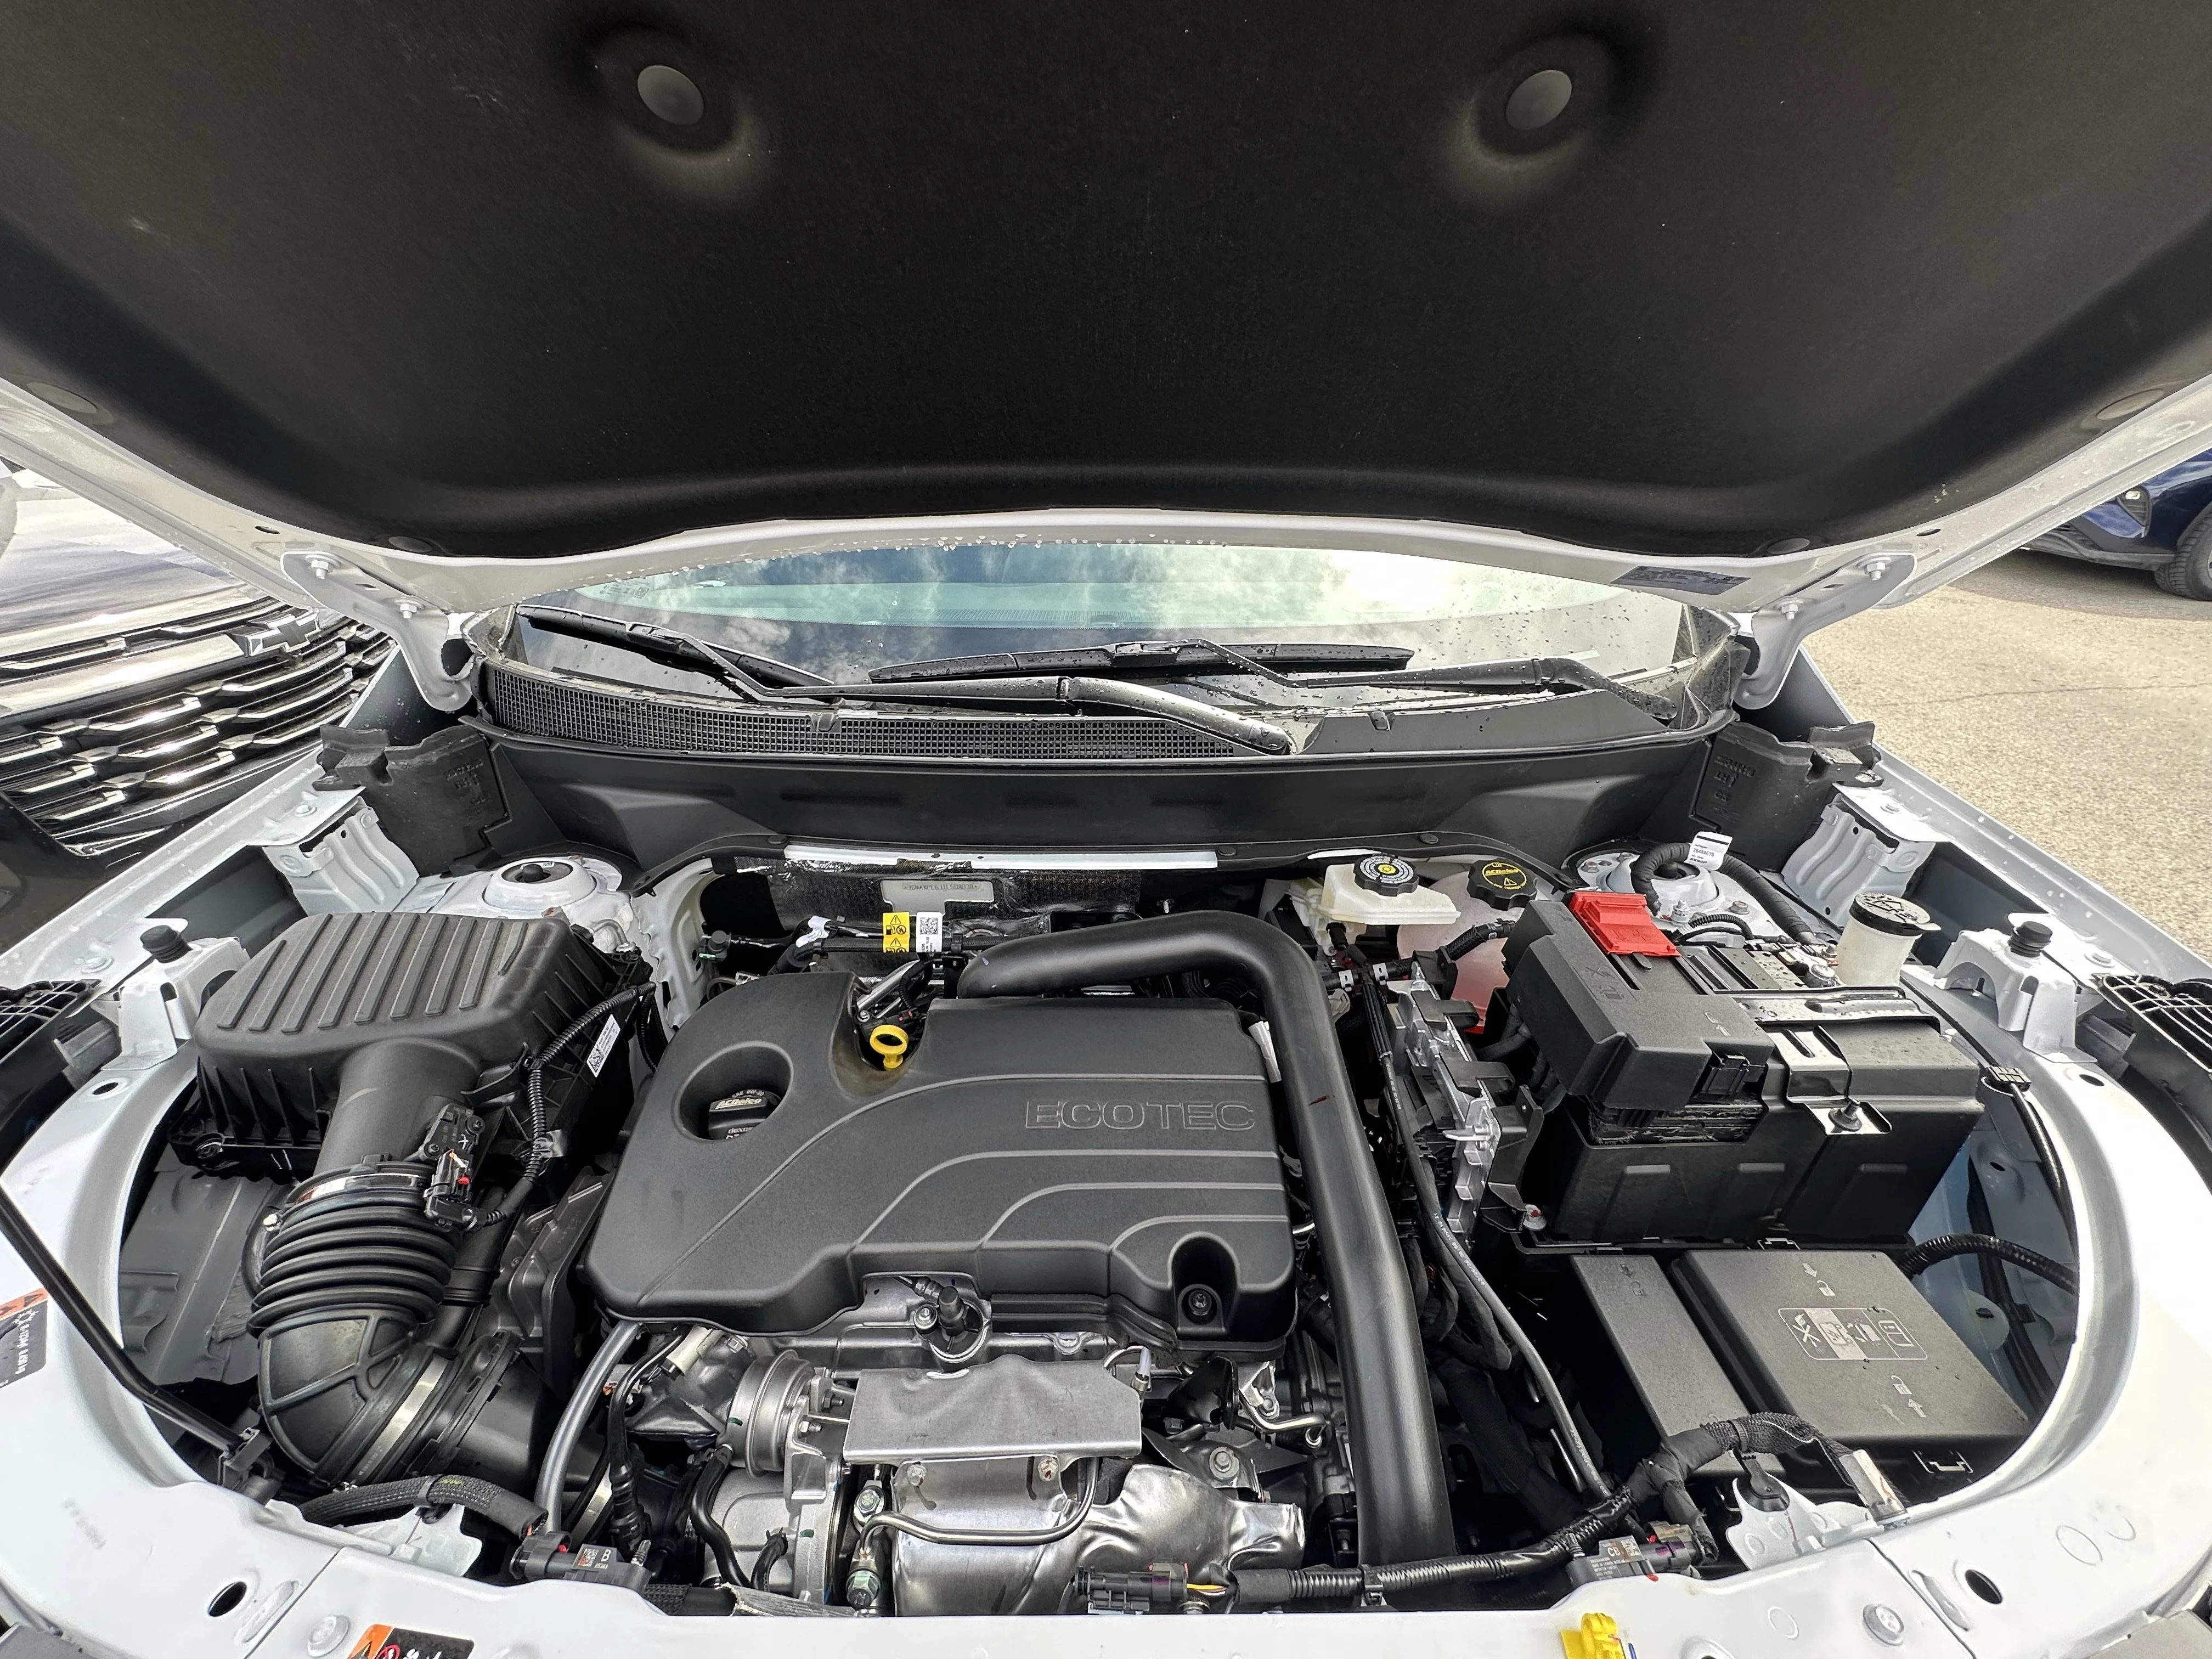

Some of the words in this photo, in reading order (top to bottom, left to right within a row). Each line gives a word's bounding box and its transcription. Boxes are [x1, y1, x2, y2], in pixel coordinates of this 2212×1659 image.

[715, 1097, 762, 1110] ACDelco
[1025, 1100, 1255, 1131] ECOTEC
[601, 1549, 611, 1561] B
[1607, 1547, 1621, 1556] CB
